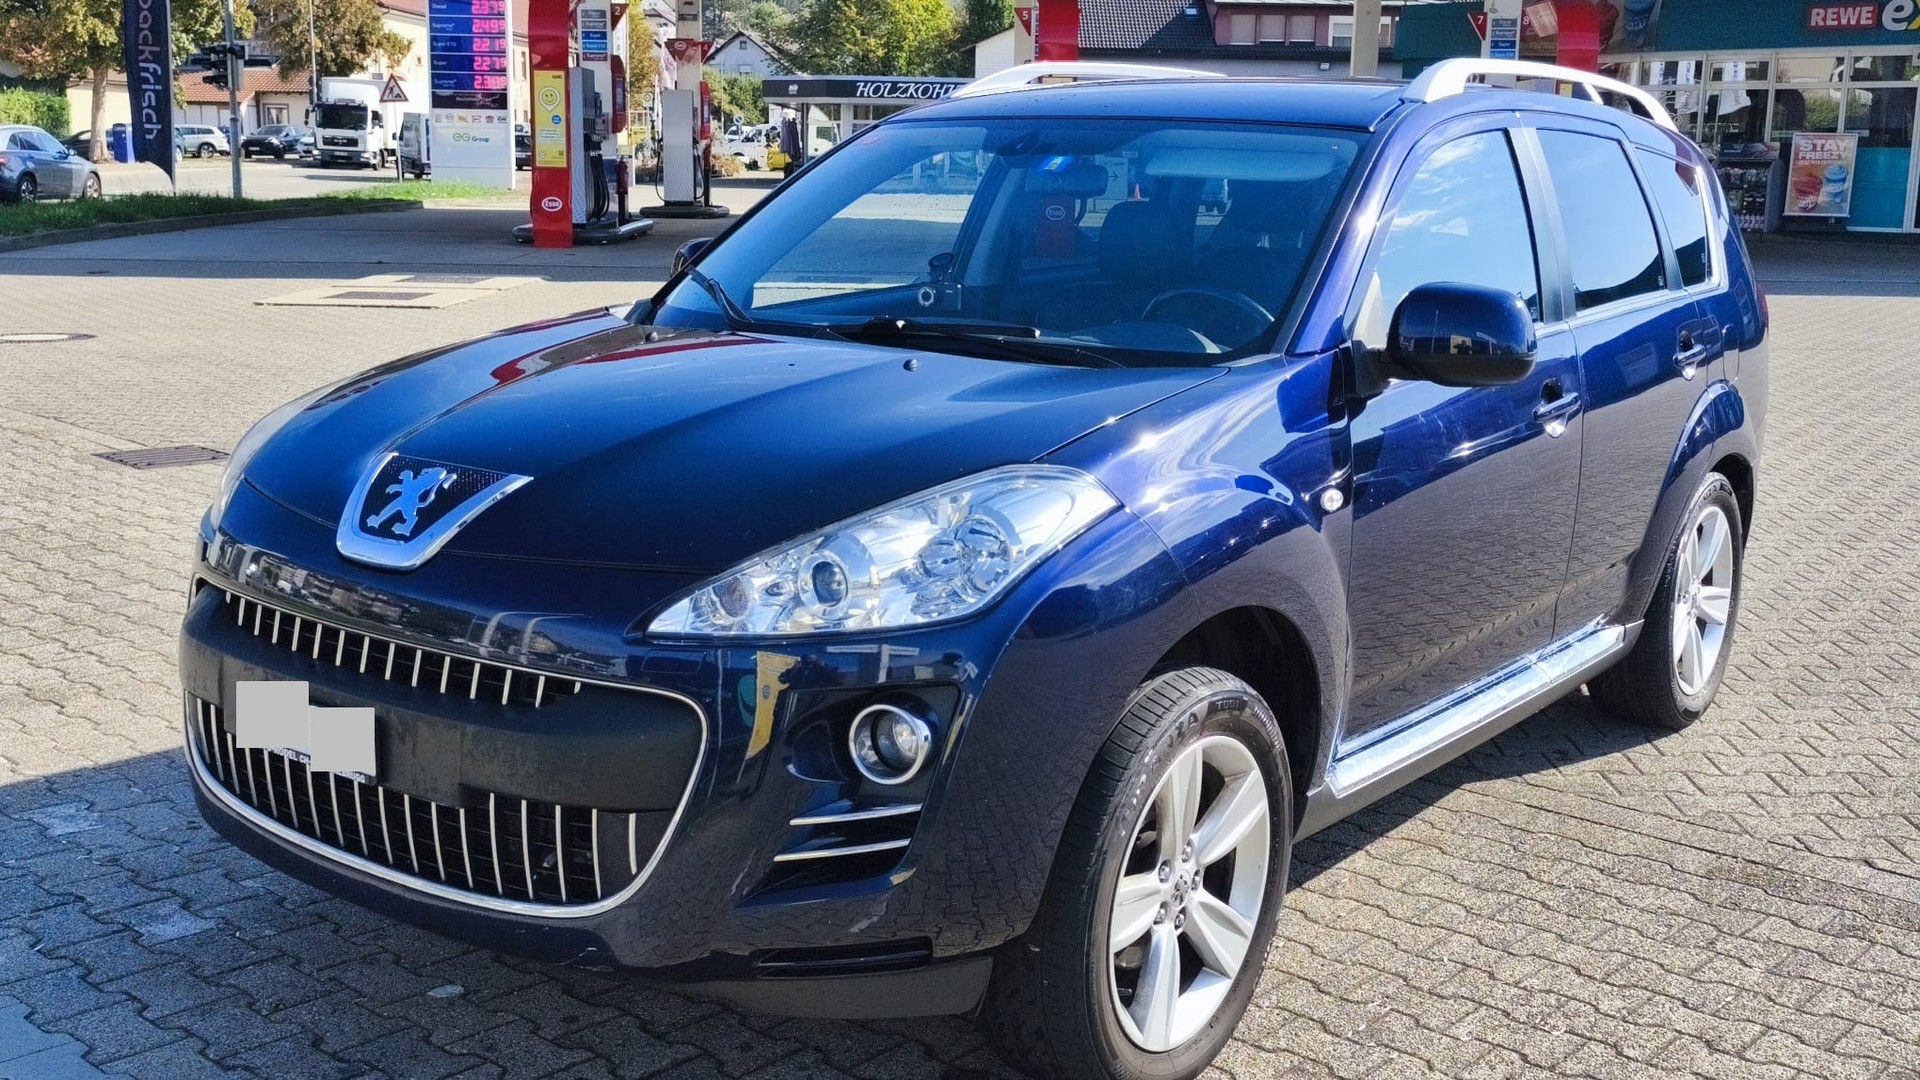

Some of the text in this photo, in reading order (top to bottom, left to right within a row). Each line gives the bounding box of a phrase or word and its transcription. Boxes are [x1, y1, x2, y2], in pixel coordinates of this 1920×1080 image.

[614, 6, 621, 15] 2
[1022, 11, 1028, 20] 5
[1477, 15, 1484, 24] 7
[1810, 6, 1873, 26] REWE
[1523, 16, 1529, 25] 8
[856, 82, 965, 99] HOLZKOH
[1799, 139, 1849, 151] STAY
[1798, 151, 1848, 160] FREEZY
